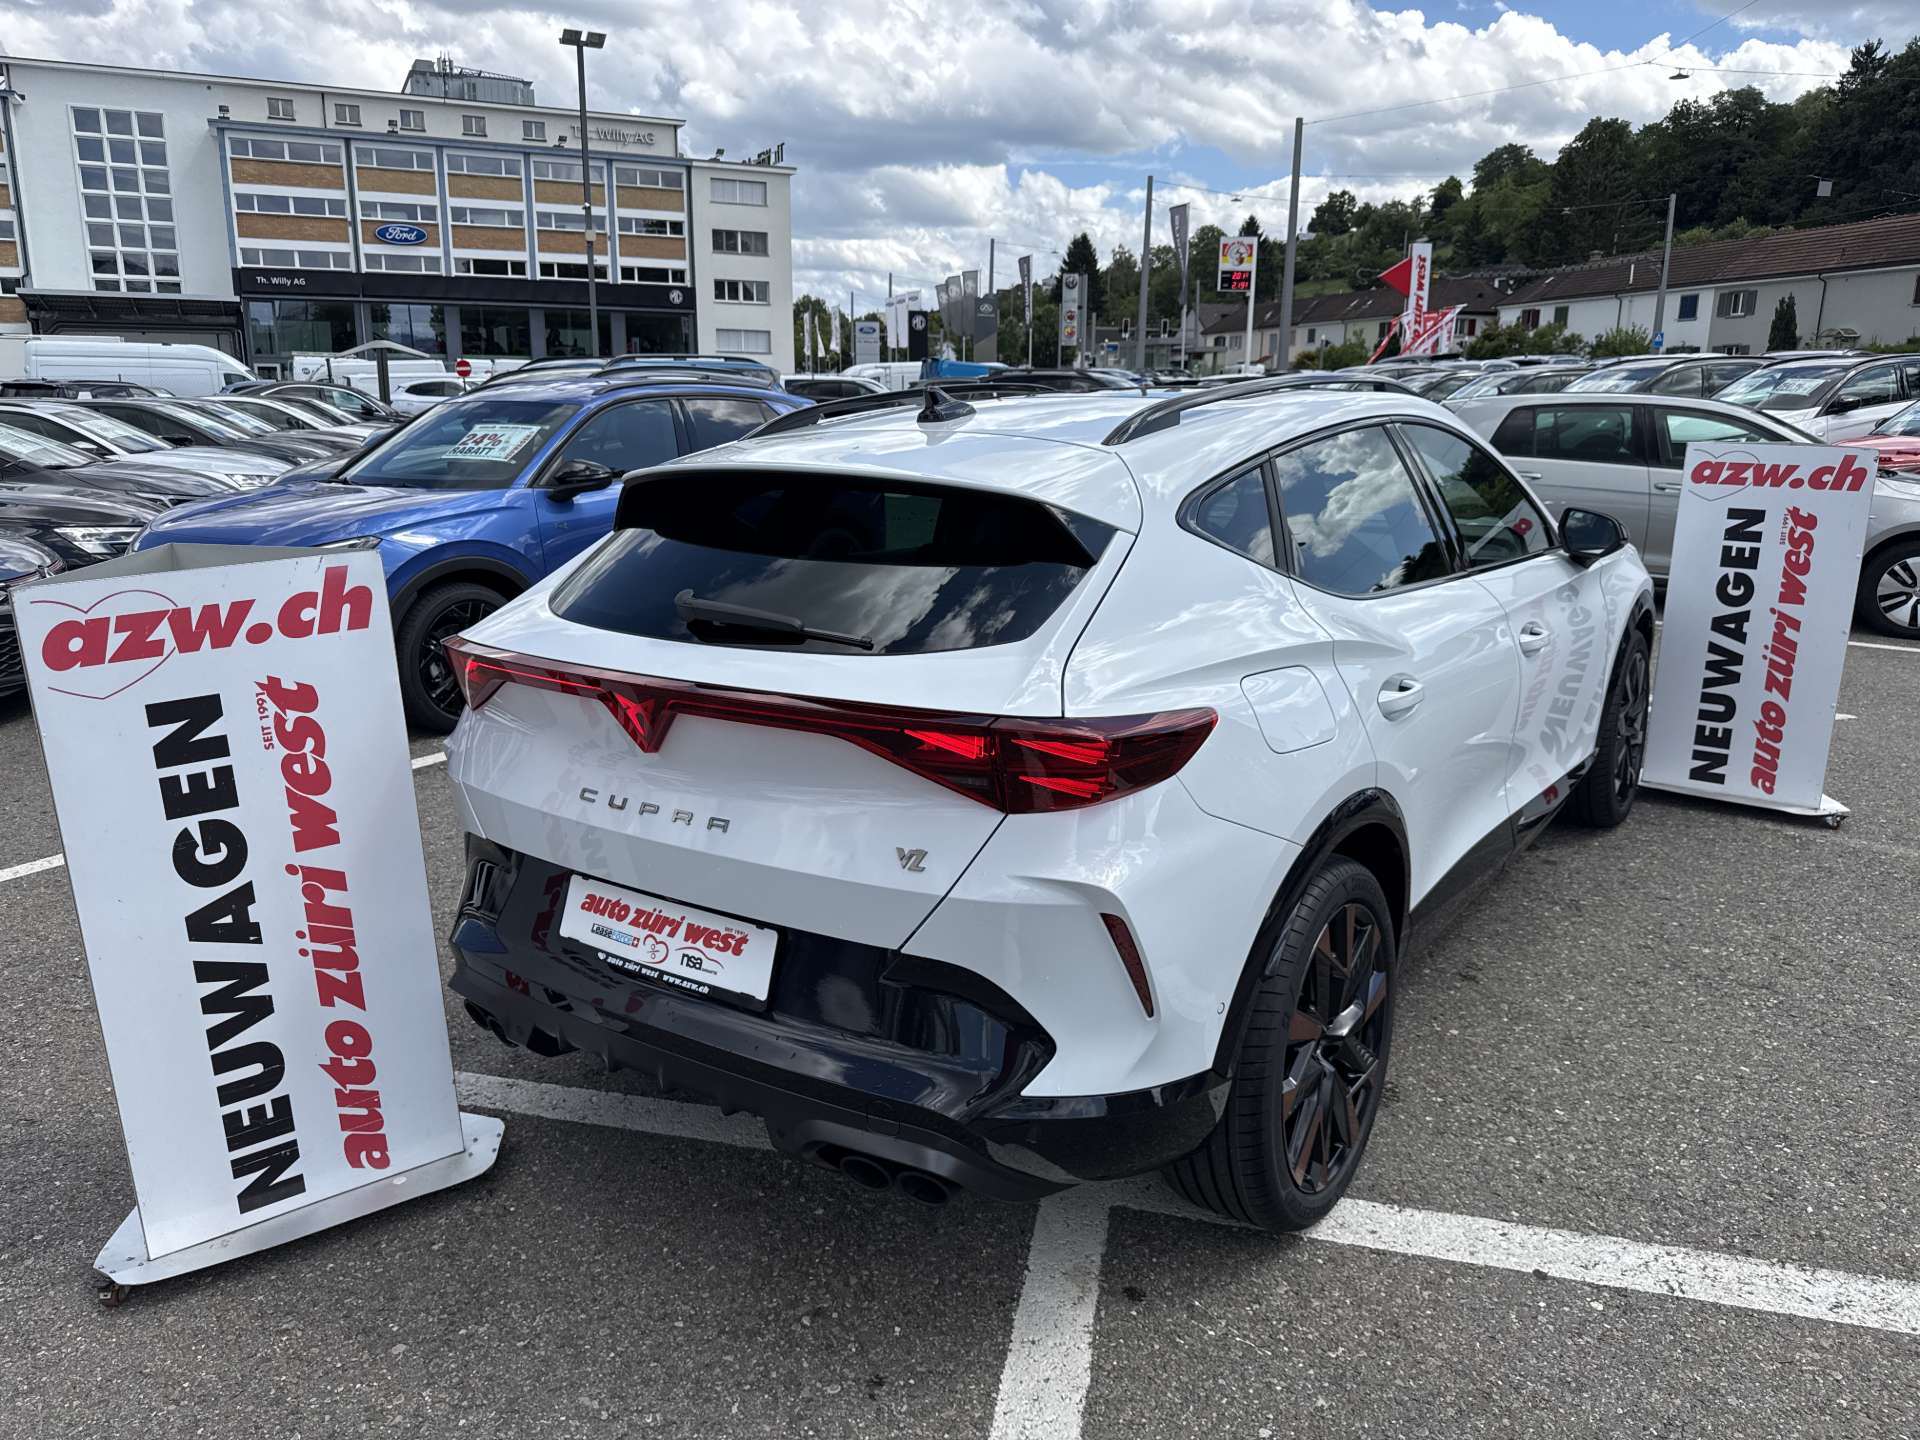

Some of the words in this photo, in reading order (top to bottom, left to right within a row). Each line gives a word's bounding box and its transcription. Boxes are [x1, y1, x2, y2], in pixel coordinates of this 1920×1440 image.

[597, 128, 631, 145] Willy
[633, 130, 656, 146] AG
[385, 226, 417, 241] Ford
[255, 276, 270, 285] Th.
[270, 276, 292, 287] Willy
[293, 277, 306, 286] AG
[449, 446, 496, 456] RABATT
[459, 433, 504, 447] 24%
[1691, 454, 1868, 492] azw.ch
[1778, 505, 1818, 606] west
[42, 565, 373, 672] azw.ch
[1689, 507, 1766, 785] NEUWAGEN
[1762, 607, 1802, 703] züri
[255, 691, 270, 722] 1991
[261, 725, 275, 751] SEIT
[1750, 700, 1786, 796] auto
[254, 675, 340, 853] west
[579, 787, 731, 833] CUPRA
[285, 863, 367, 1012] züri
[580, 891, 631, 923] auto
[628, 908, 686, 939] züri
[683, 922, 749, 957] west
[145, 693, 306, 1215] NEUWAGEN
[606, 956, 624, 967] auto
[641, 967, 660, 978] west
[662, 974, 711, 994] www.azw.ch
[680, 953, 703, 971] nsa
[318, 1019, 391, 1171] auto
